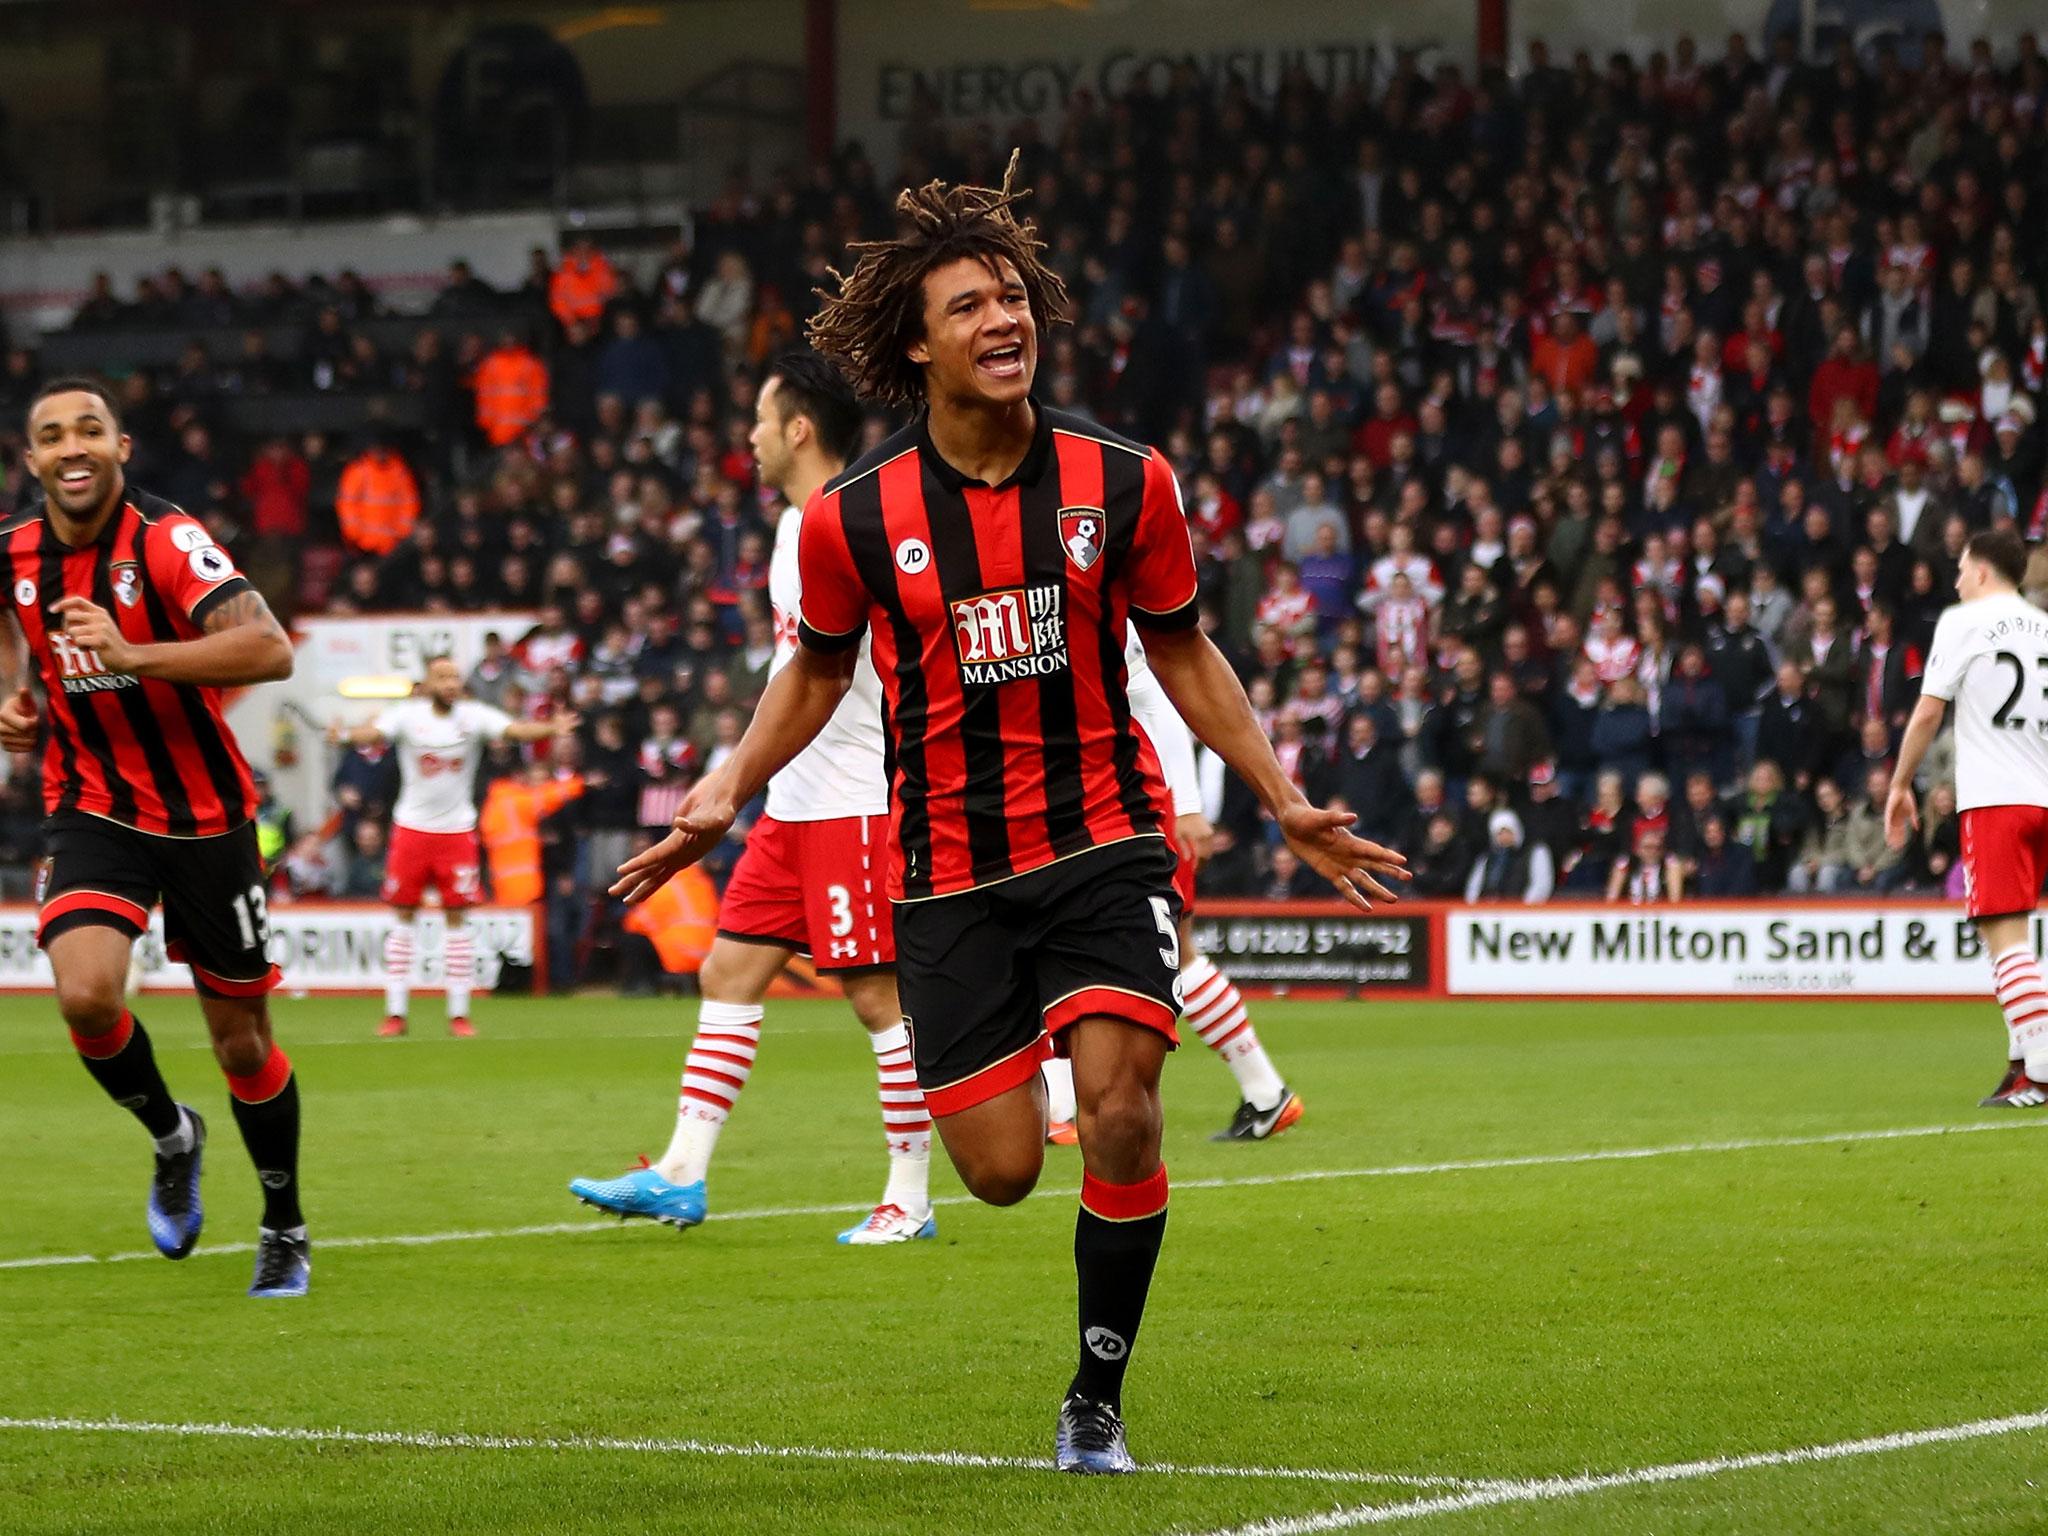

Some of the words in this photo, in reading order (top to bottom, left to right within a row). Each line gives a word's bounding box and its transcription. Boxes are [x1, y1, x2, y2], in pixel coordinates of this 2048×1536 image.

[878, 58, 1083, 118] ENERGY
[904, 547, 923, 566] JD
[61, 674, 140, 693] MANSION
[961, 647, 1068, 685] MANSION
[233, 885, 269, 950] 13
[827, 883, 854, 938] 3
[1147, 895, 1180, 970] 5
[1227, 922, 1310, 954] 01202
[1469, 922, 1573, 962] New
[1592, 918, 1747, 962] Milton
[1767, 918, 1885, 962] Sand
[1904, 922, 1936, 962] &
